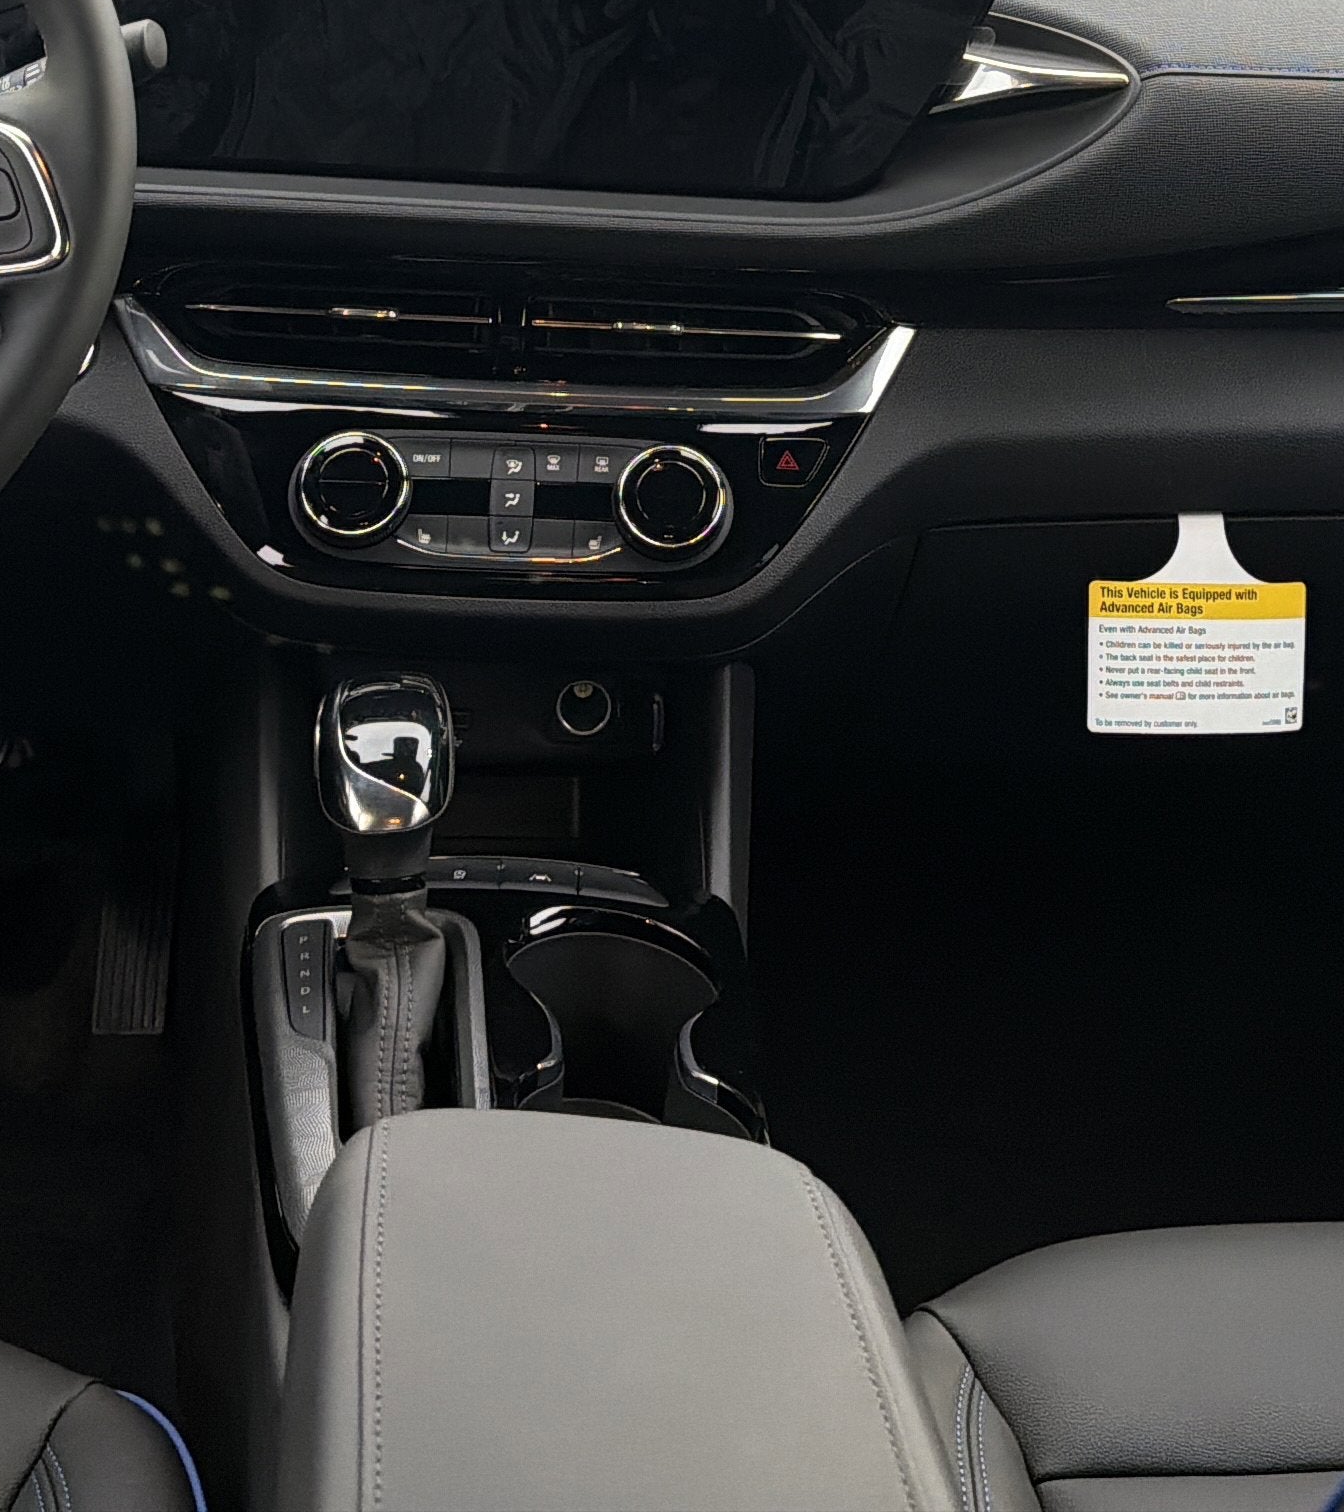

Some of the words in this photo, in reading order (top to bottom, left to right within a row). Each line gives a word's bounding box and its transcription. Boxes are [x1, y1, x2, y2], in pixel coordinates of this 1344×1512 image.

[412, 454, 442, 464] ON/OFF
[1100, 586, 1123, 599] This
[1126, 587, 1166, 599] Vehicle
[1169, 588, 1179, 599] is
[1182, 588, 1232, 603] Equipped
[1235, 588, 1258, 600] with
[1099, 601, 1154, 613] Advanced
[1157, 602, 1173, 614] Air
[1176, 603, 1203, 616] Bags
[1099, 624, 1117, 633] Even
[1119, 625, 1136, 633] with
[1138, 625, 1174, 634] Advanced
[1176, 626, 1186, 634] Air
[1188, 626, 1206, 636] Bags
[1105, 640, 1136, 648] Children
[1195, 642, 1225, 651] seriously
[1227, 642, 1250, 651] injured
[1105, 653, 1118, 661] The
[1120, 653, 1137, 661] back
[1197, 655, 1216, 664] place
[1105, 666, 1125, 674] Never
[1147, 667, 1185, 676] rear-facing
[1186, 667, 1202, 675] child
[1204, 667, 1218, 675] seat
[1105, 678, 1130, 688] Always
[1163, 679, 1179, 687] belts
[1105, 691, 1118, 699] See
[1120, 692, 1147, 700] owner's
[1149, 692, 1174, 700] manual
[1217, 692, 1252, 700] information
[1114, 719, 1142, 727] removed
[1184, 721, 1198, 729] only.
